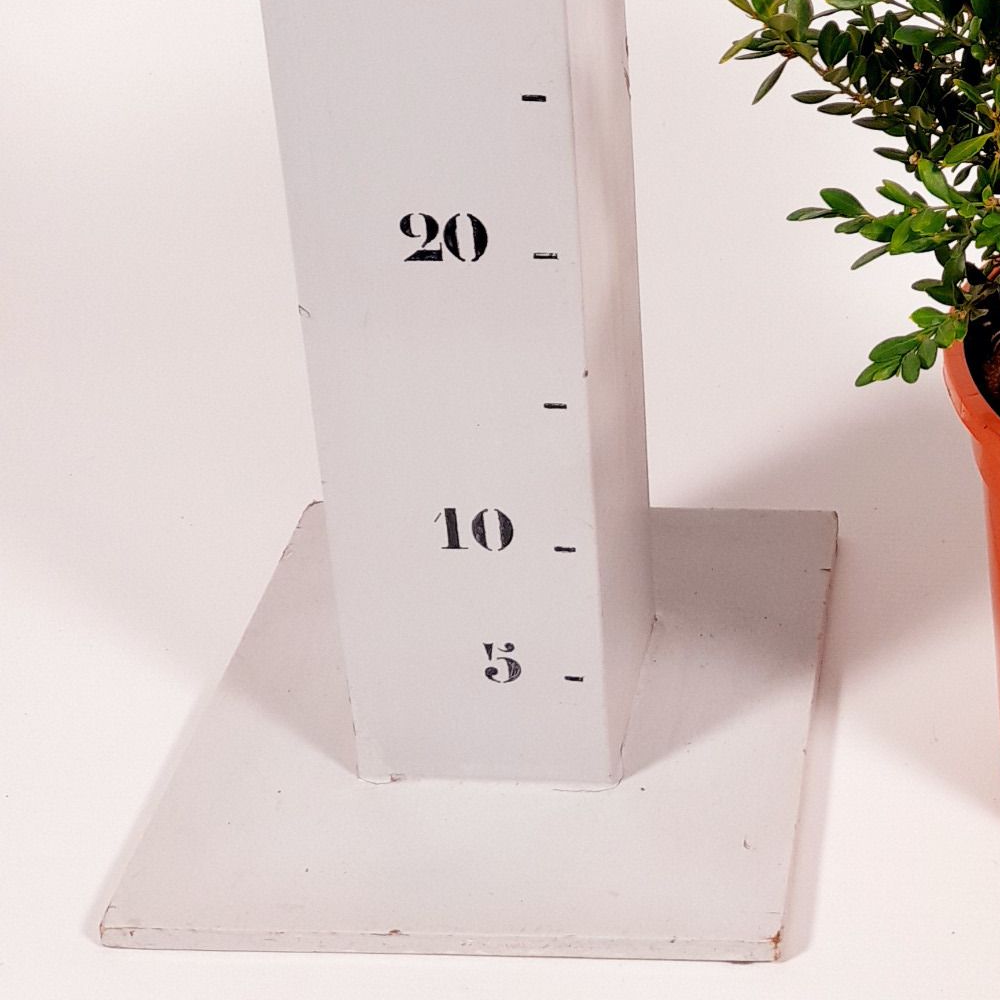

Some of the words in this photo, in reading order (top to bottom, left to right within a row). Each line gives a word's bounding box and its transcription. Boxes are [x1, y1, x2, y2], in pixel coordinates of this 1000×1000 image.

[399, 212, 489, 263] 20
[433, 507, 514, 553] 10
[483, 642, 522, 684] 5
